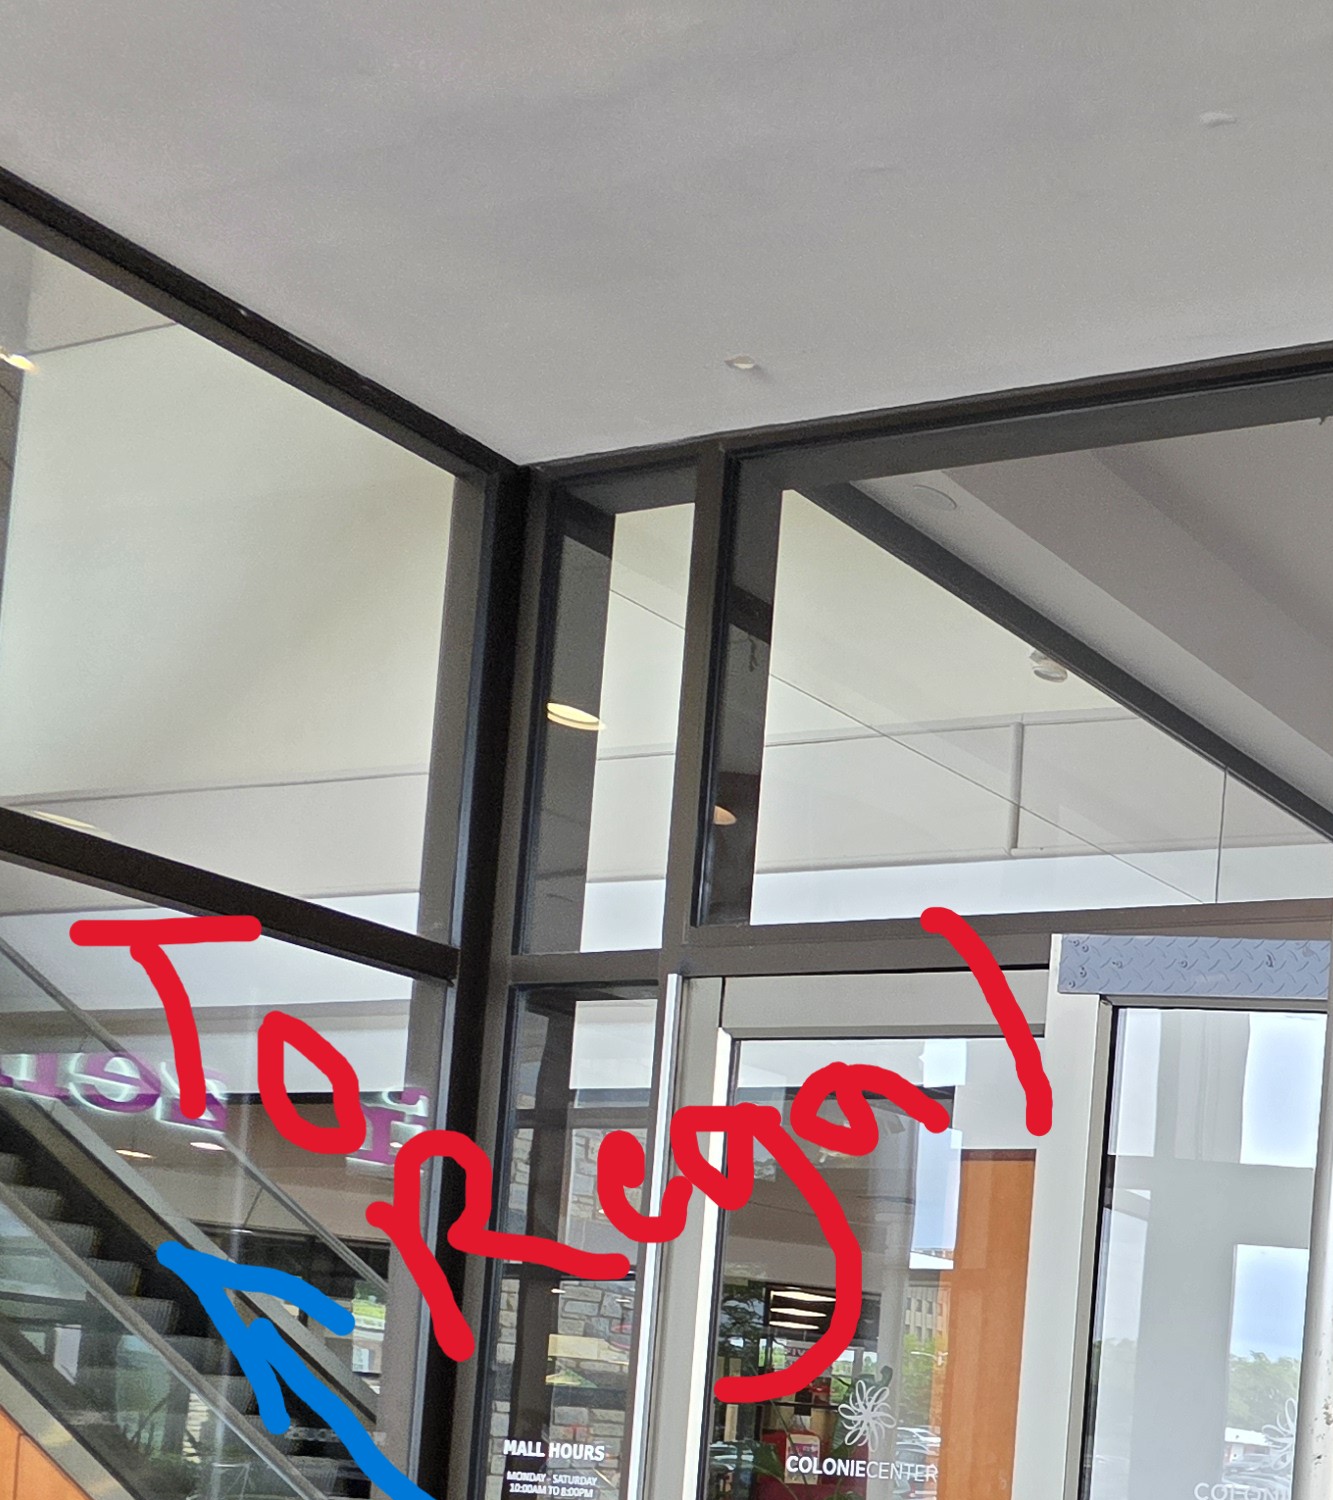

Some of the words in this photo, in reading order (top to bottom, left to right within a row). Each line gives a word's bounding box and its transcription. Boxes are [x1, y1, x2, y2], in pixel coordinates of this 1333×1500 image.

[503, 1439, 546, 1457] MALL
[548, 1442, 605, 1461] HOURS
[785, 1455, 939, 1483] COLONIECENTER
[506, 1471, 546, 1482] MONDAY
[552, 1474, 598, 1486] SATURDAY
[548, 1486, 560, 1496] TO
